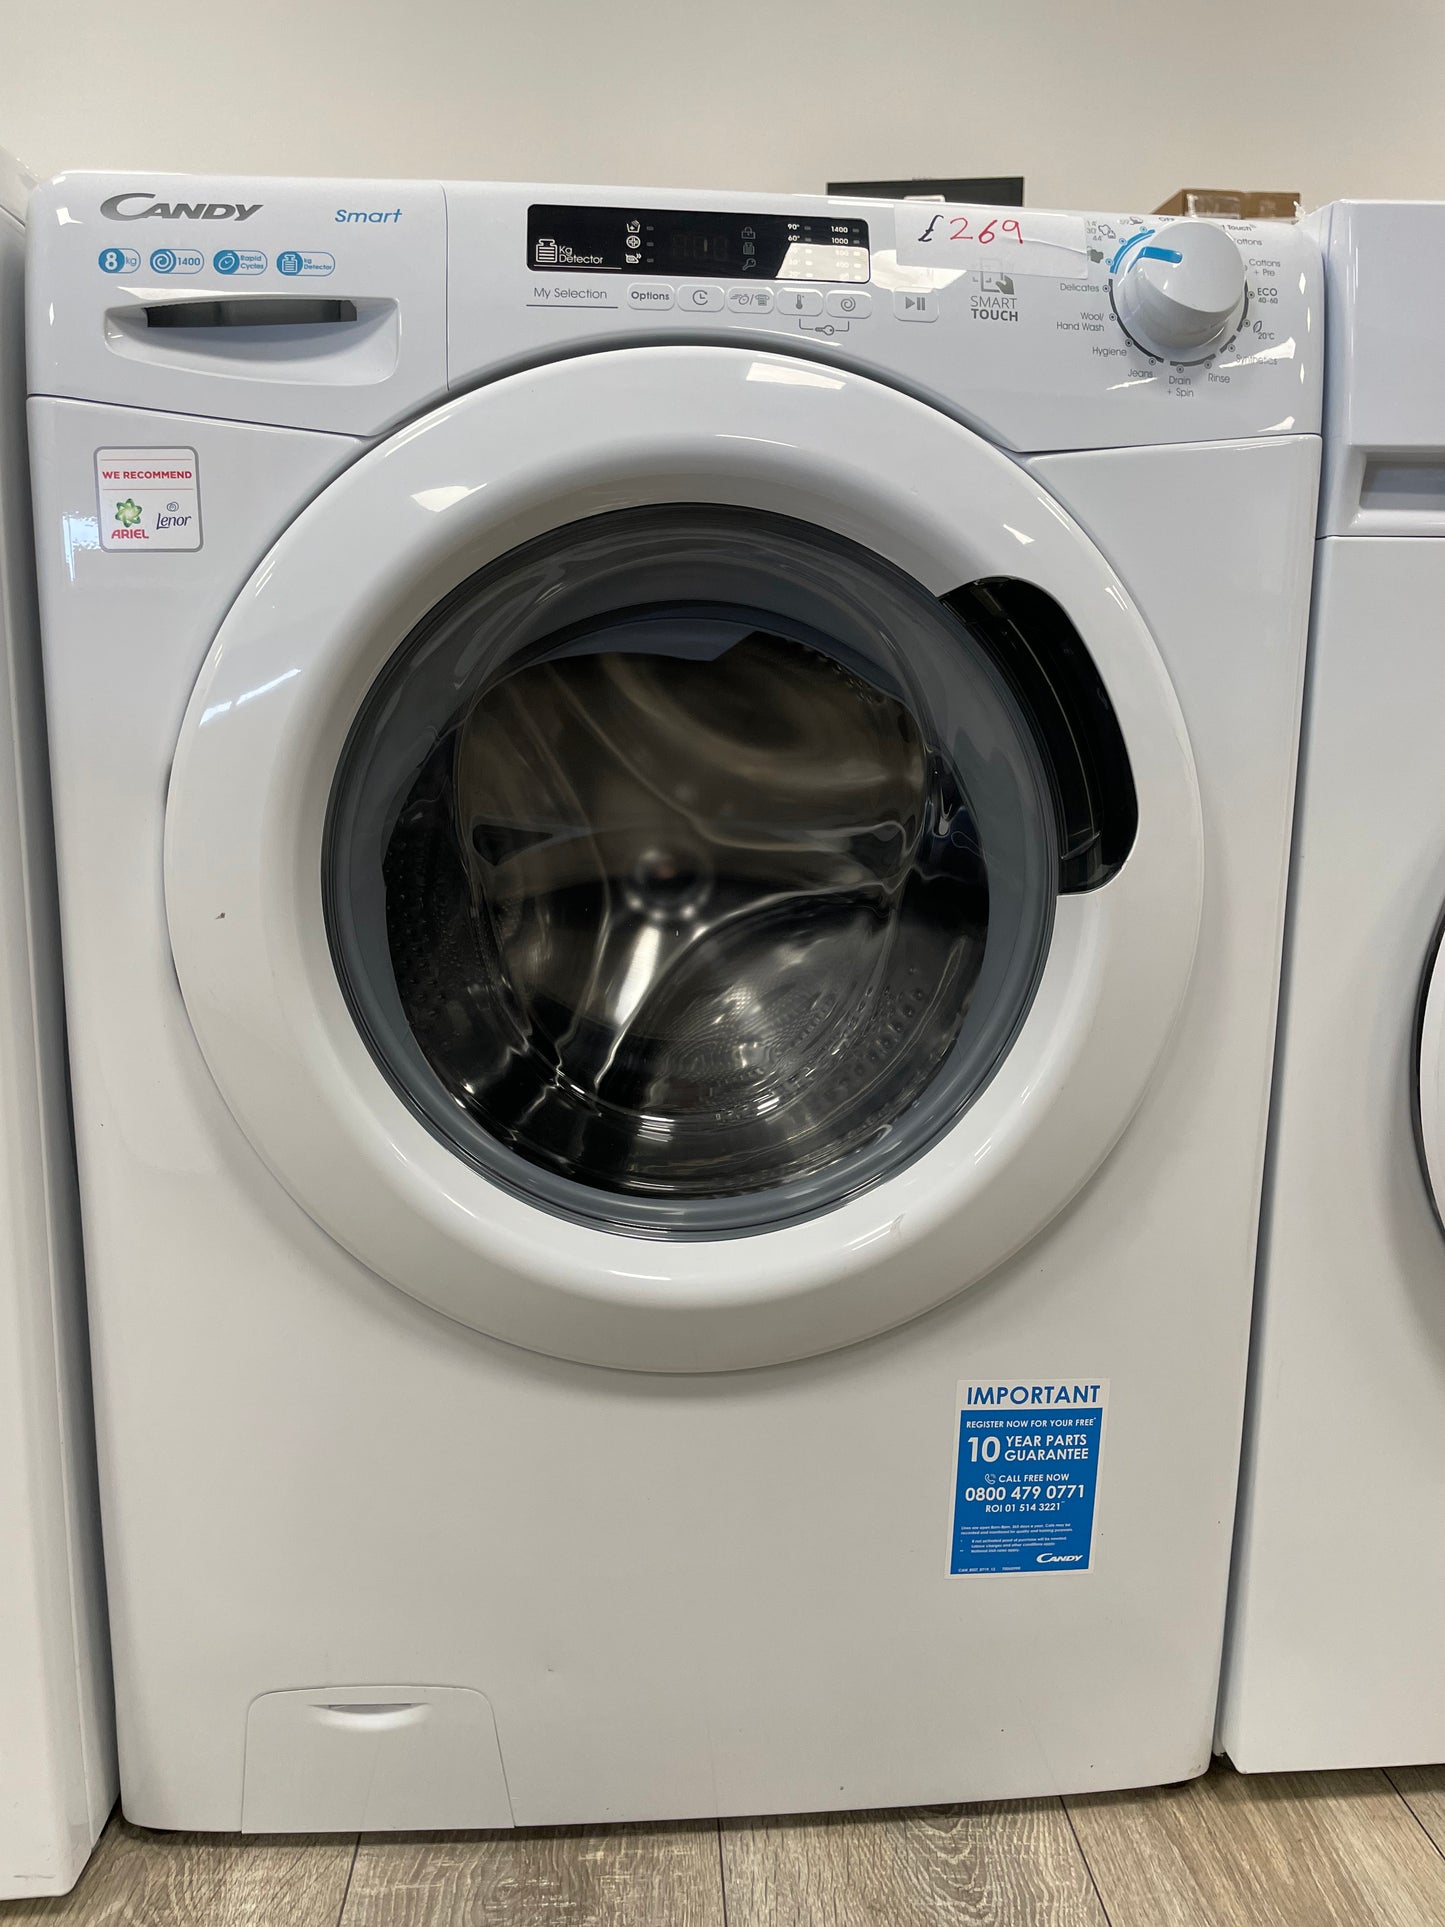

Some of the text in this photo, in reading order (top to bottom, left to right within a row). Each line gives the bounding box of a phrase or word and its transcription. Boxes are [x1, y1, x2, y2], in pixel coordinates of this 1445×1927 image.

[100, 192, 265, 222] CANDY
[334, 208, 403, 224] Smart
[831, 225, 849, 234] 1400
[831, 237, 849, 245] 1000
[1234, 238, 1263, 246] ottons
[558, 245, 573, 257] Kg
[104, 252, 138, 270] 8 kg
[177, 256, 201, 267] 1400
[240, 254, 262, 264] Rapid
[558, 254, 604, 265] Detector
[1248, 258, 1281, 268] Cottons
[240, 262, 264, 271] Cycles
[303, 264, 333, 272] Detector
[1262, 268, 1276, 277] Pre
[1060, 282, 1100, 293] Delicates
[1257, 287, 1278, 297] ECO
[533, 287, 608, 300] My Selection
[630, 290, 670, 303] Options
[970, 295, 1019, 310] SMART
[970, 308, 1019, 323] TOUCH
[1056, 321, 1105, 332] Hand Wash
[1092, 346, 1127, 358] Hygiene
[1127, 369, 1153, 378] Jeans
[1208, 373, 1231, 384] Rinse
[1168, 375, 1191, 385] Drain
[1175, 387, 1194, 398] Spin
[102, 470, 193, 480] WE RECOMMEND
[156, 512, 192, 530] Lenor
[111, 529, 149, 540] ARIEL
[966, 1385, 1101, 1406] IMPORTANT
[966, 1420, 1004, 1429] REGISTER
[1006, 1419, 1029, 1428] NOW
[1030, 1419, 1048, 1428] FOR
[1049, 1418, 1074, 1427] YOUR
[1005, 1434, 1088, 1448] YEAR PARTS
[967, 1436, 1001, 1463] 10
[1004, 1448, 1089, 1461] GUARANTEE
[998, 1473, 1070, 1483] CALL FREE NOW
[965, 1484, 1085, 1502] 0800 479 0771
[985, 1504, 1003, 1513] ROI
[1004, 1504, 1017, 1512] 01
[1018, 1503, 1037, 1512] 514
[1036, 1552, 1084, 1564] CANDY
